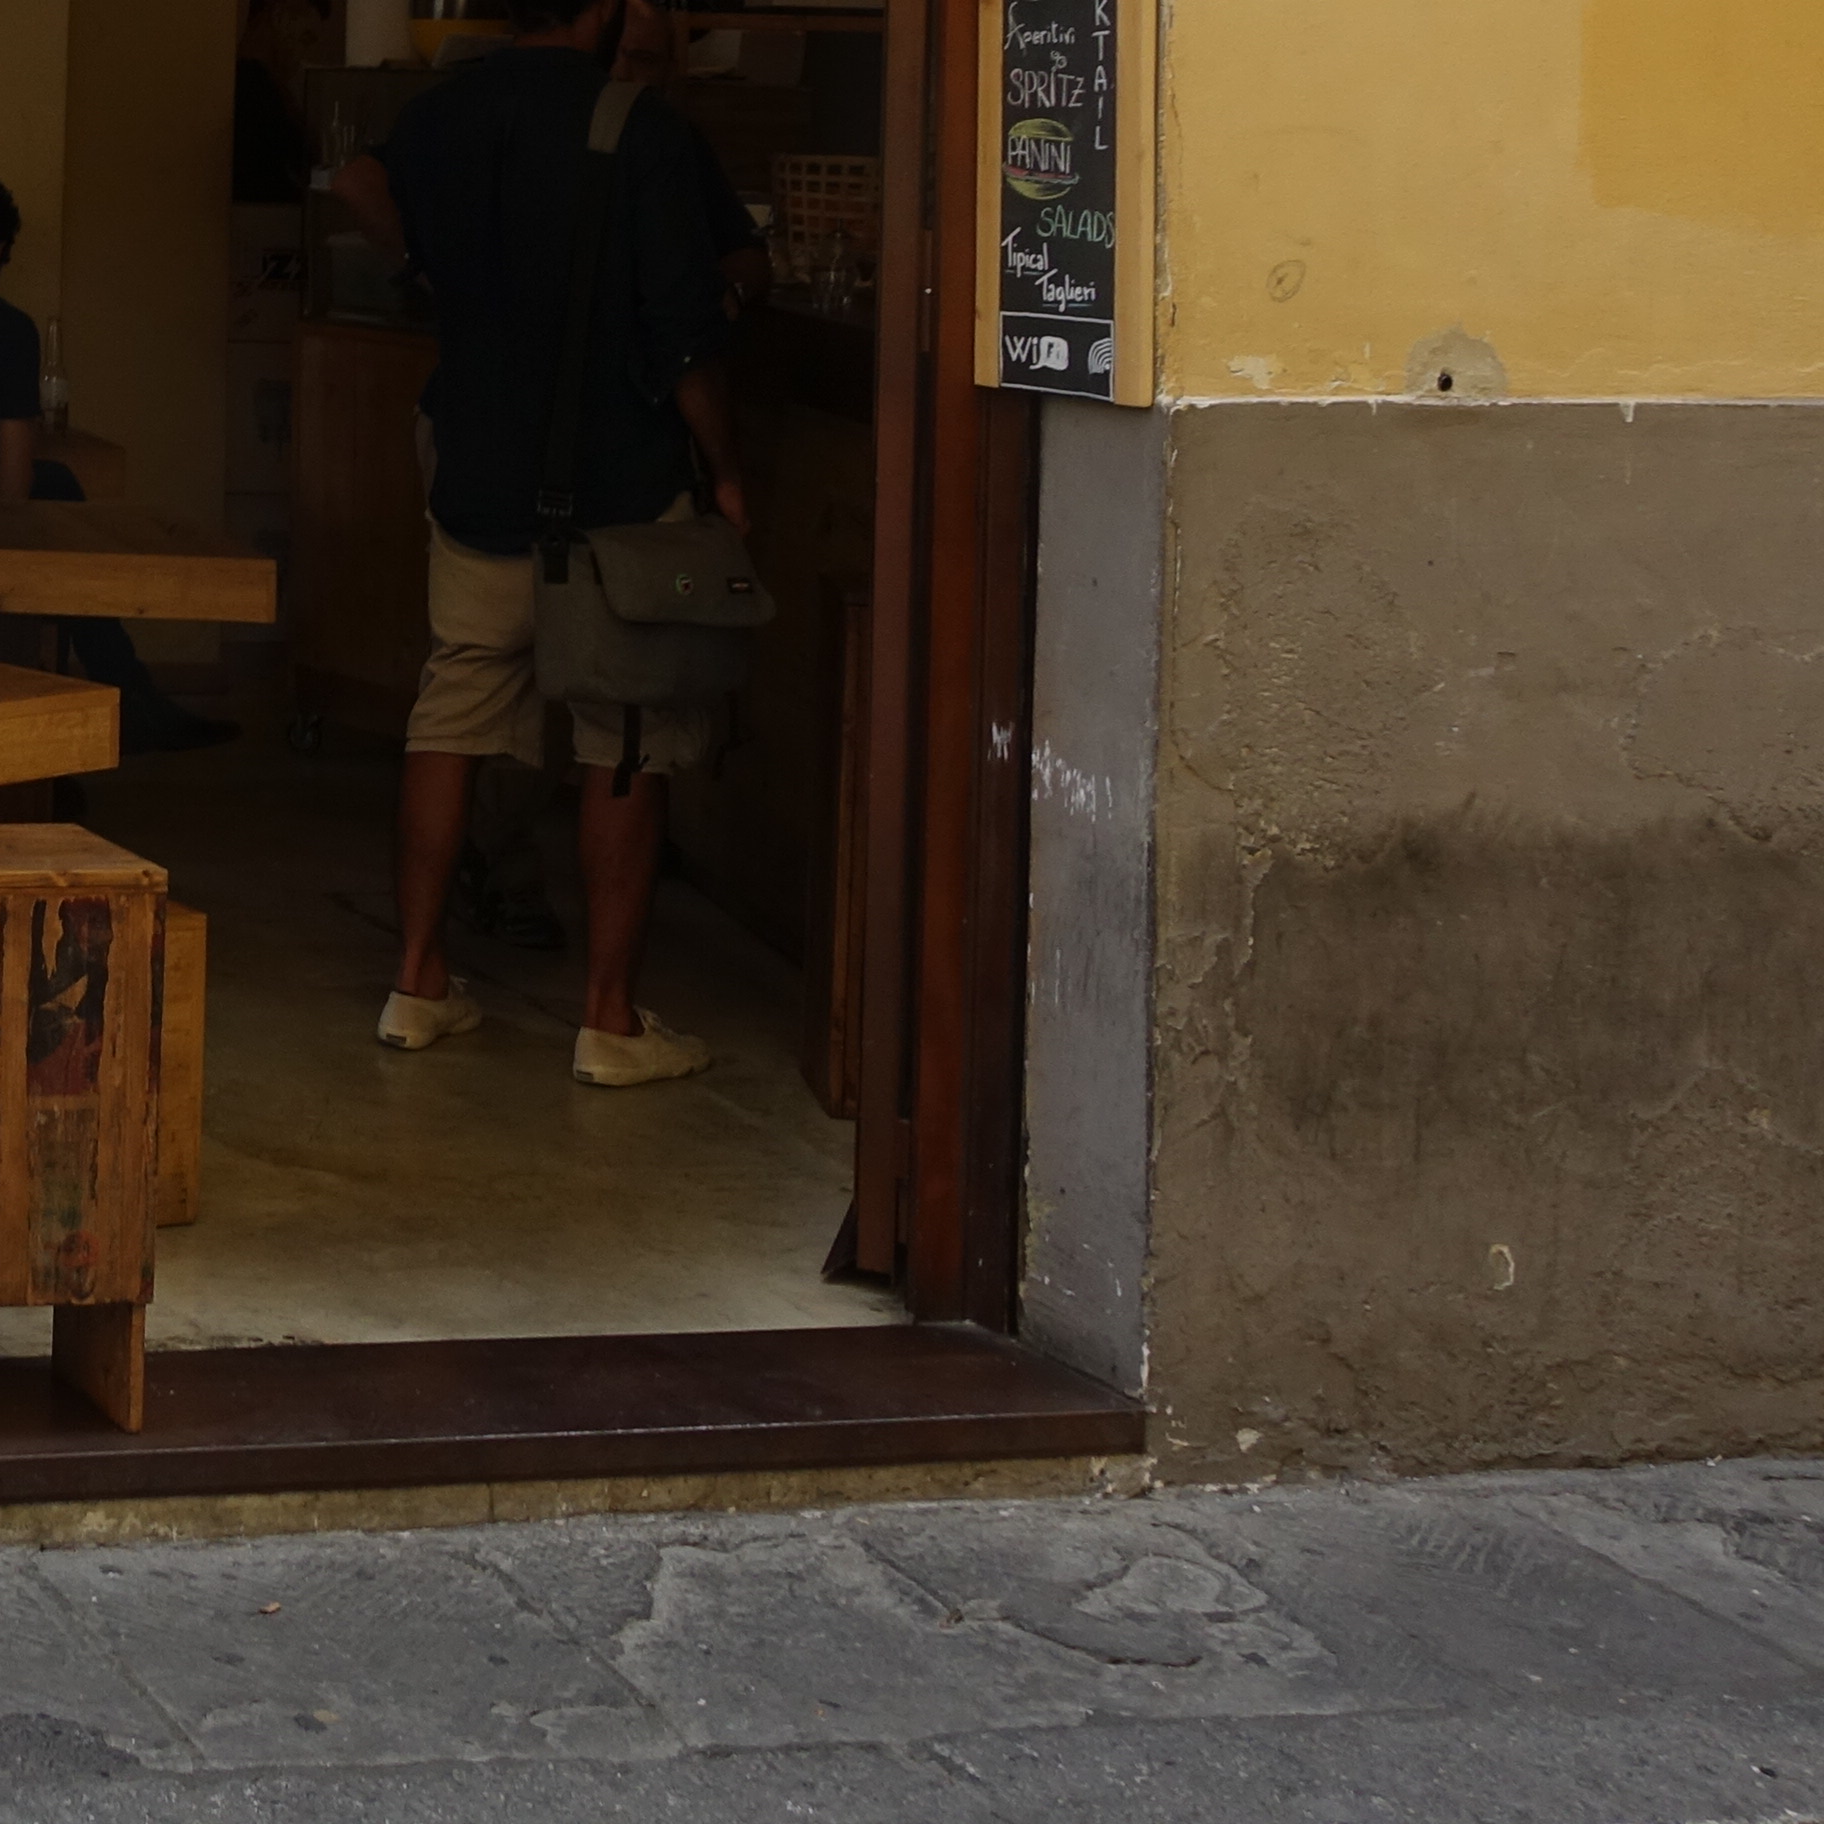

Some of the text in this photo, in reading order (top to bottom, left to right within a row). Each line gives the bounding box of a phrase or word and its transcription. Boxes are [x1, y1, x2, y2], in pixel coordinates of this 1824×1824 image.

[1007, 65, 1086, 108] SPRITZ
[1008, 135, 1071, 174] PANINI
[1036, 205, 1115, 248] SALADS
[1001, 227, 1049, 277] Tipical
[1035, 269, 1096, 312] Taglieri
